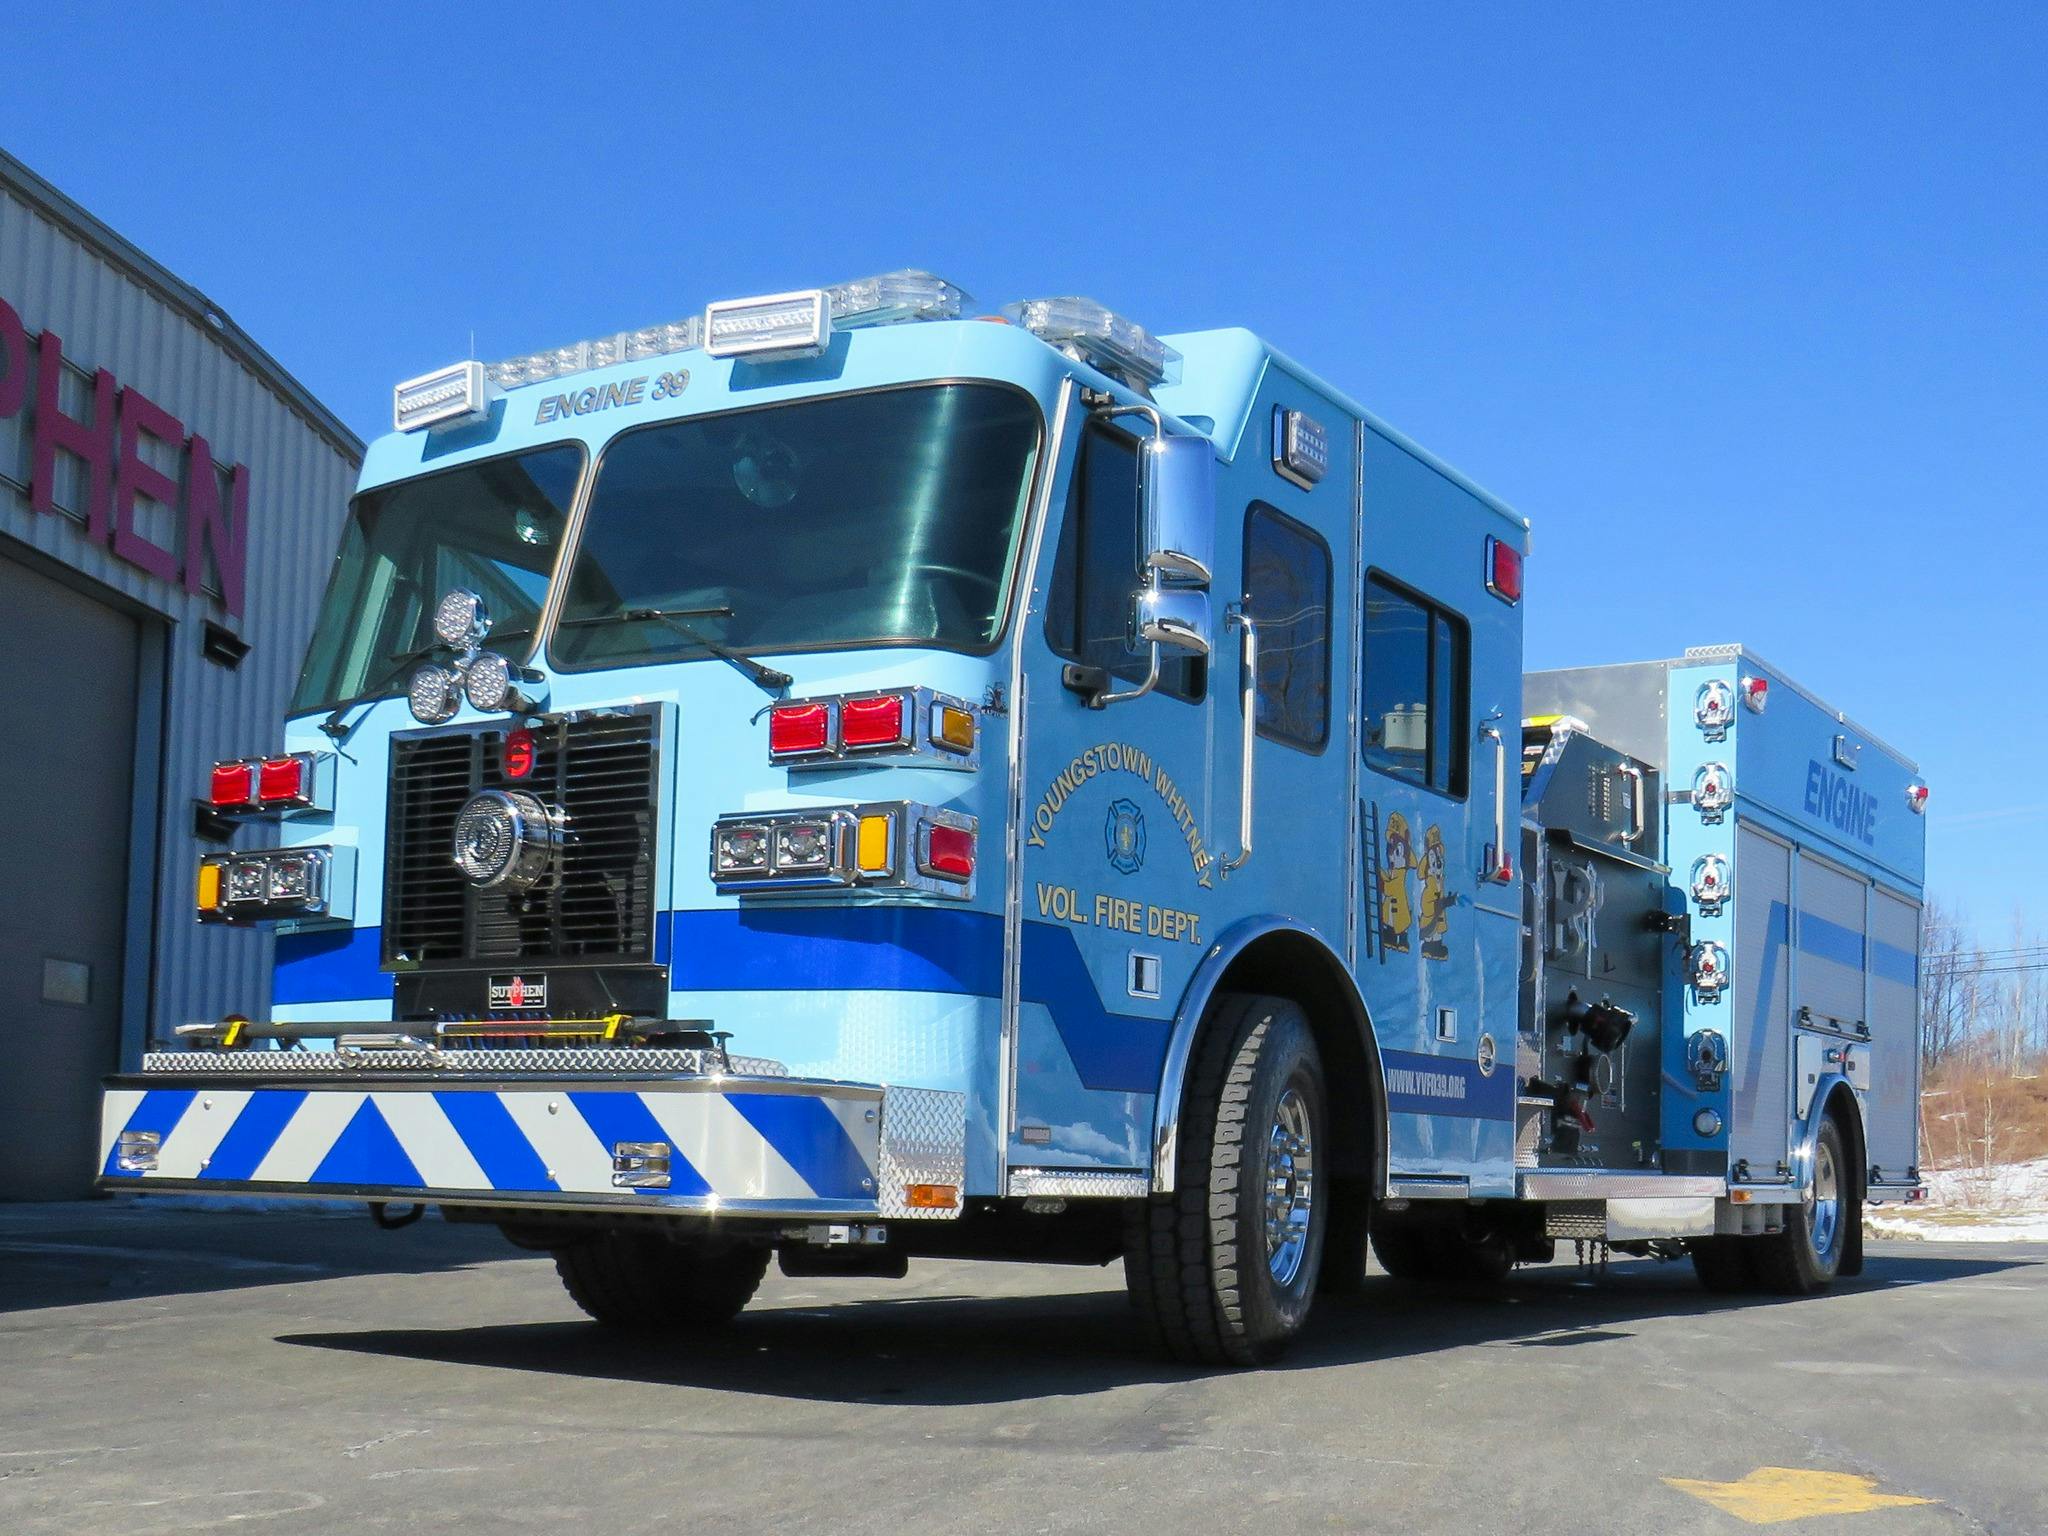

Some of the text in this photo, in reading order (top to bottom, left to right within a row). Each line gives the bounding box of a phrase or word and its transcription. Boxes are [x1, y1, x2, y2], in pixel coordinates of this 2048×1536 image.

[534, 368, 691, 426] ENGINE 39
[1026, 742, 1212, 890] YOUNGSTOWN WHITNEY
[1804, 759, 1878, 846] ENGINE
[1036, 882, 1201, 944] VOL. FIRE DEPT.
[491, 984, 544, 998] SUTPHEN
